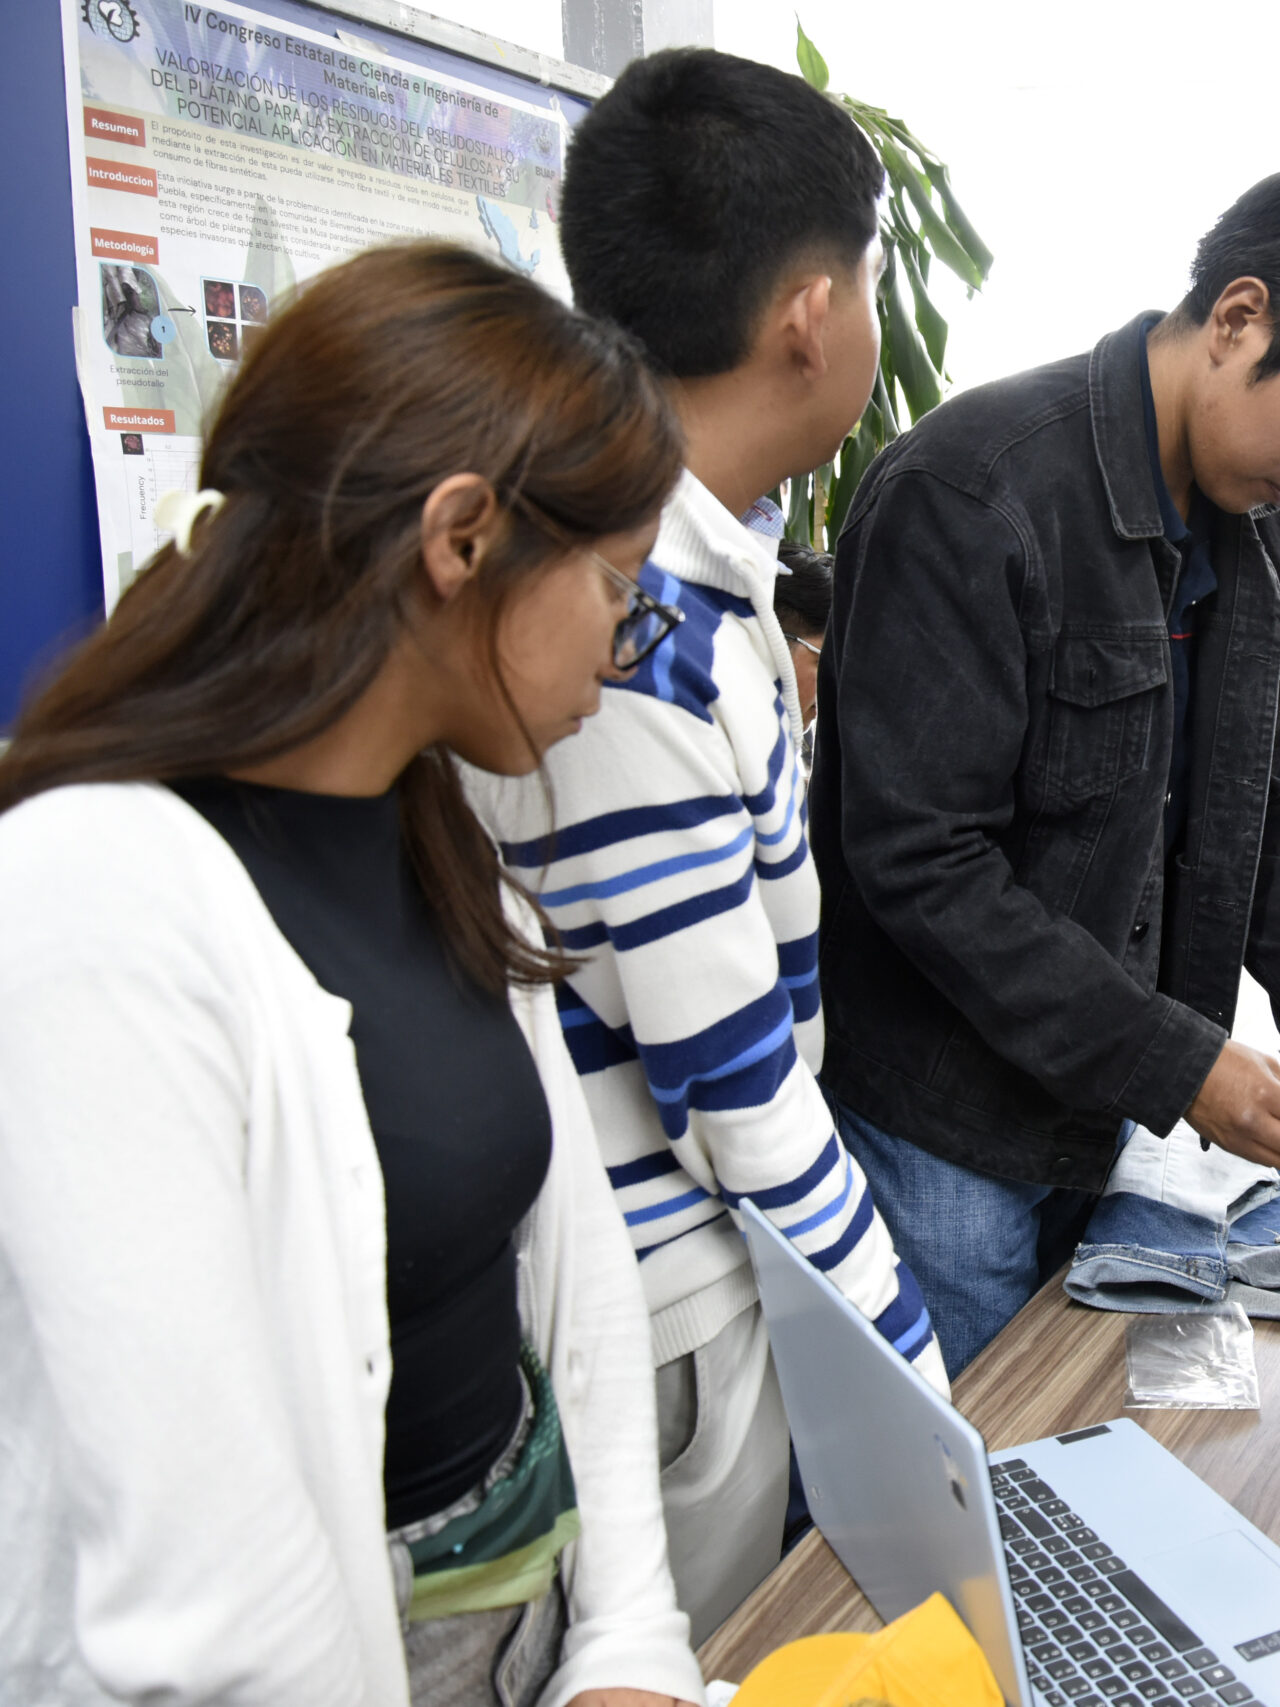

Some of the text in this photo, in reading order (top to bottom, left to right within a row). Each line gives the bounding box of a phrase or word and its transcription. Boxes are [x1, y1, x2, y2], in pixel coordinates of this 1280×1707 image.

[185, 5, 499, 118] IV Congreso Estatal de Ciencia e Ingeniería de
[323, 69, 395, 105] Materiales
[156, 47, 514, 165] VALORIZACIÓN DE LOS RESIDUOS DEL PSEUDOSTALLO
[91, 117, 139, 137] Resumen
[151, 68, 520, 184] DEL PLÁTANO PARA LA EXTRACCIÓN DE CELULOSA Y SU
[151, 120, 159, 130] El
[162, 124, 201, 142] propósito
[205, 135, 217, 145] de
[220, 139, 237, 149] esta
[240, 141, 289, 161] investigación
[317, 161, 334, 172] valor
[152, 136, 191, 151] mediante
[194, 143, 201, 153] la
[204, 147, 245, 164] extracción
[248, 156, 258, 167] de
[261, 161, 278, 171] esta
[177, 97, 506, 199] POTENCIAL APLICACIÓN EN MATERIALES TEXTILES
[153, 150, 192, 165] consumo
[193, 156, 204, 167] de
[205, 158, 228, 173] fibras
[89, 167, 154, 188] Introduccion
[157, 171, 175, 183] Esta
[177, 175, 212, 190] iniciativa
[214, 185, 235, 197] surge
[244, 190, 264, 201] partir
[266, 193, 276, 202] de
[286, 197, 330, 215] problemática
[158, 199, 177, 209] esta
[179, 200, 205, 215] región
[207, 207, 230, 219] crece
[232, 211, 243, 221] de
[245, 213, 268, 226] forma
[159, 212, 184, 223] como
[186, 214, 207, 227] árbol
[209, 218, 220, 230] de
[190, 191, 256, 212] específicamente
[279, 209, 317, 225] comunidad
[94, 237, 155, 257] Metodología
[160, 226, 198, 240] especies
[199, 229, 236, 246] invasoras
[238, 239, 254, 249] que
[110, 363, 169, 377] Extracción del
[116, 377, 165, 389] pseudotallo
[110, 413, 165, 427] Resultados
